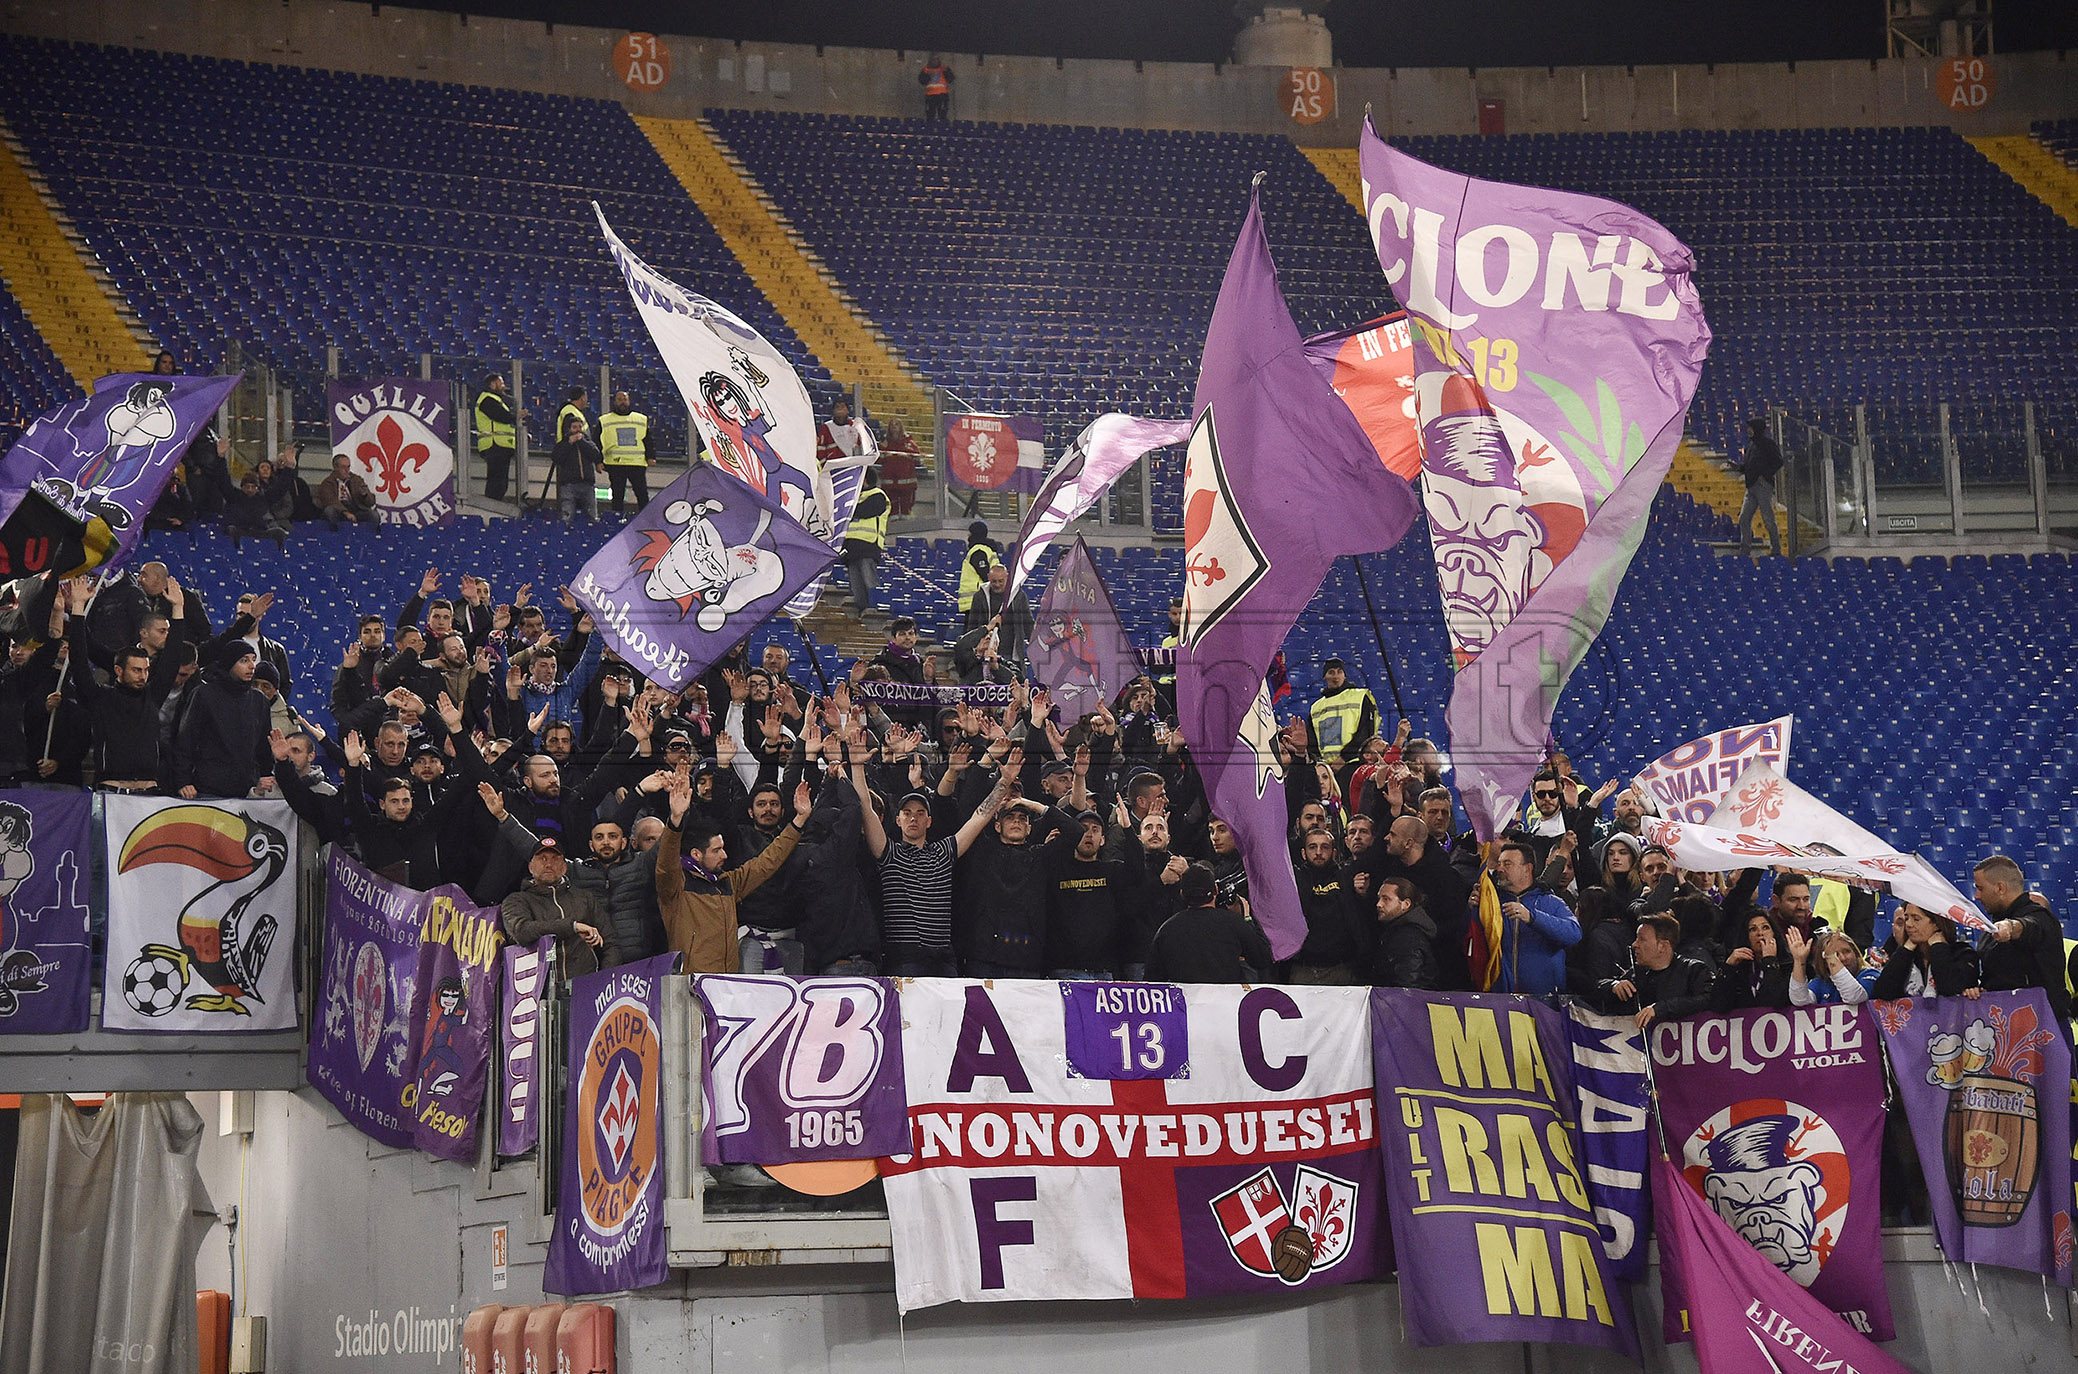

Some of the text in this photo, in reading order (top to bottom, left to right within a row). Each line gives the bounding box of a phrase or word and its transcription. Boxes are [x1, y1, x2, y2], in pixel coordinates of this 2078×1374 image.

[628, 35, 657, 60] 51
[626, 61, 664, 85] AD
[1291, 70, 1321, 93] 50
[1953, 59, 1984, 82] 50
[1291, 95, 1322, 118] AS
[1951, 84, 1988, 107] AD
[1356, 328, 1384, 361] IN
[1467, 336, 1519, 393] 13
[334, 383, 445, 426] QUELLI
[335, 855, 407, 922] FIORENTINA
[7, 965, 19, 982] di
[20, 960, 61, 980] Sempre
[595, 973, 653, 1016] mai scesi
[1094, 985, 1175, 1015] ASTORI
[946, 985, 1310, 1094] A C
[1110, 1021, 1166, 1073] 13
[1426, 1002, 1557, 1103] MA
[1651, 1004, 1864, 1074] CICLONE
[1790, 1053, 1867, 1071] VIOLA
[784, 1109, 865, 1149] 1965
[1433, 1106, 1592, 1214] RAS
[969, 1175, 1039, 1291] F
[1475, 1222, 1615, 1328] MA
[335, 1309, 391, 1358] Stadio
